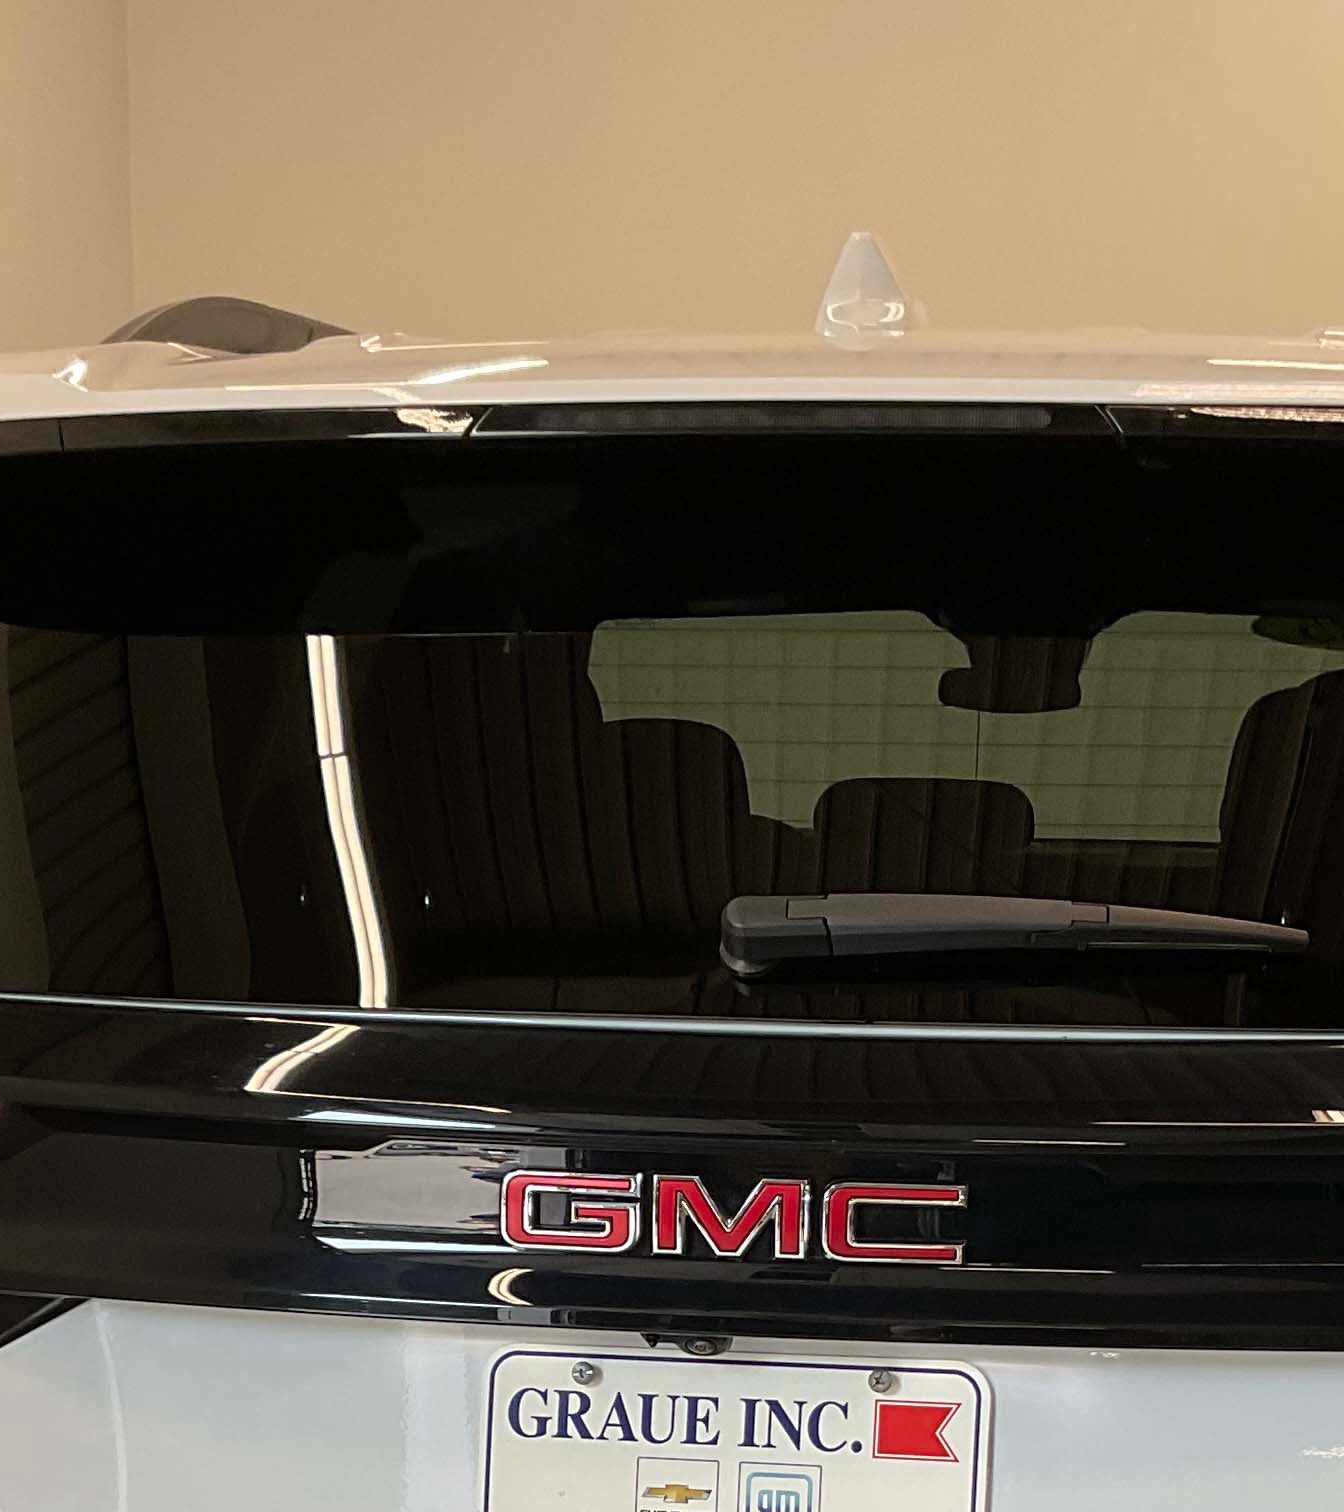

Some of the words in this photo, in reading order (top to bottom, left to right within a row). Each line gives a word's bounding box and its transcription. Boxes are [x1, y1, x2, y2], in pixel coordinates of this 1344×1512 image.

[502, 1171, 967, 1264] GMC
[507, 1387, 720, 1447] GRAUE
[737, 1398, 863, 1454] INC.
